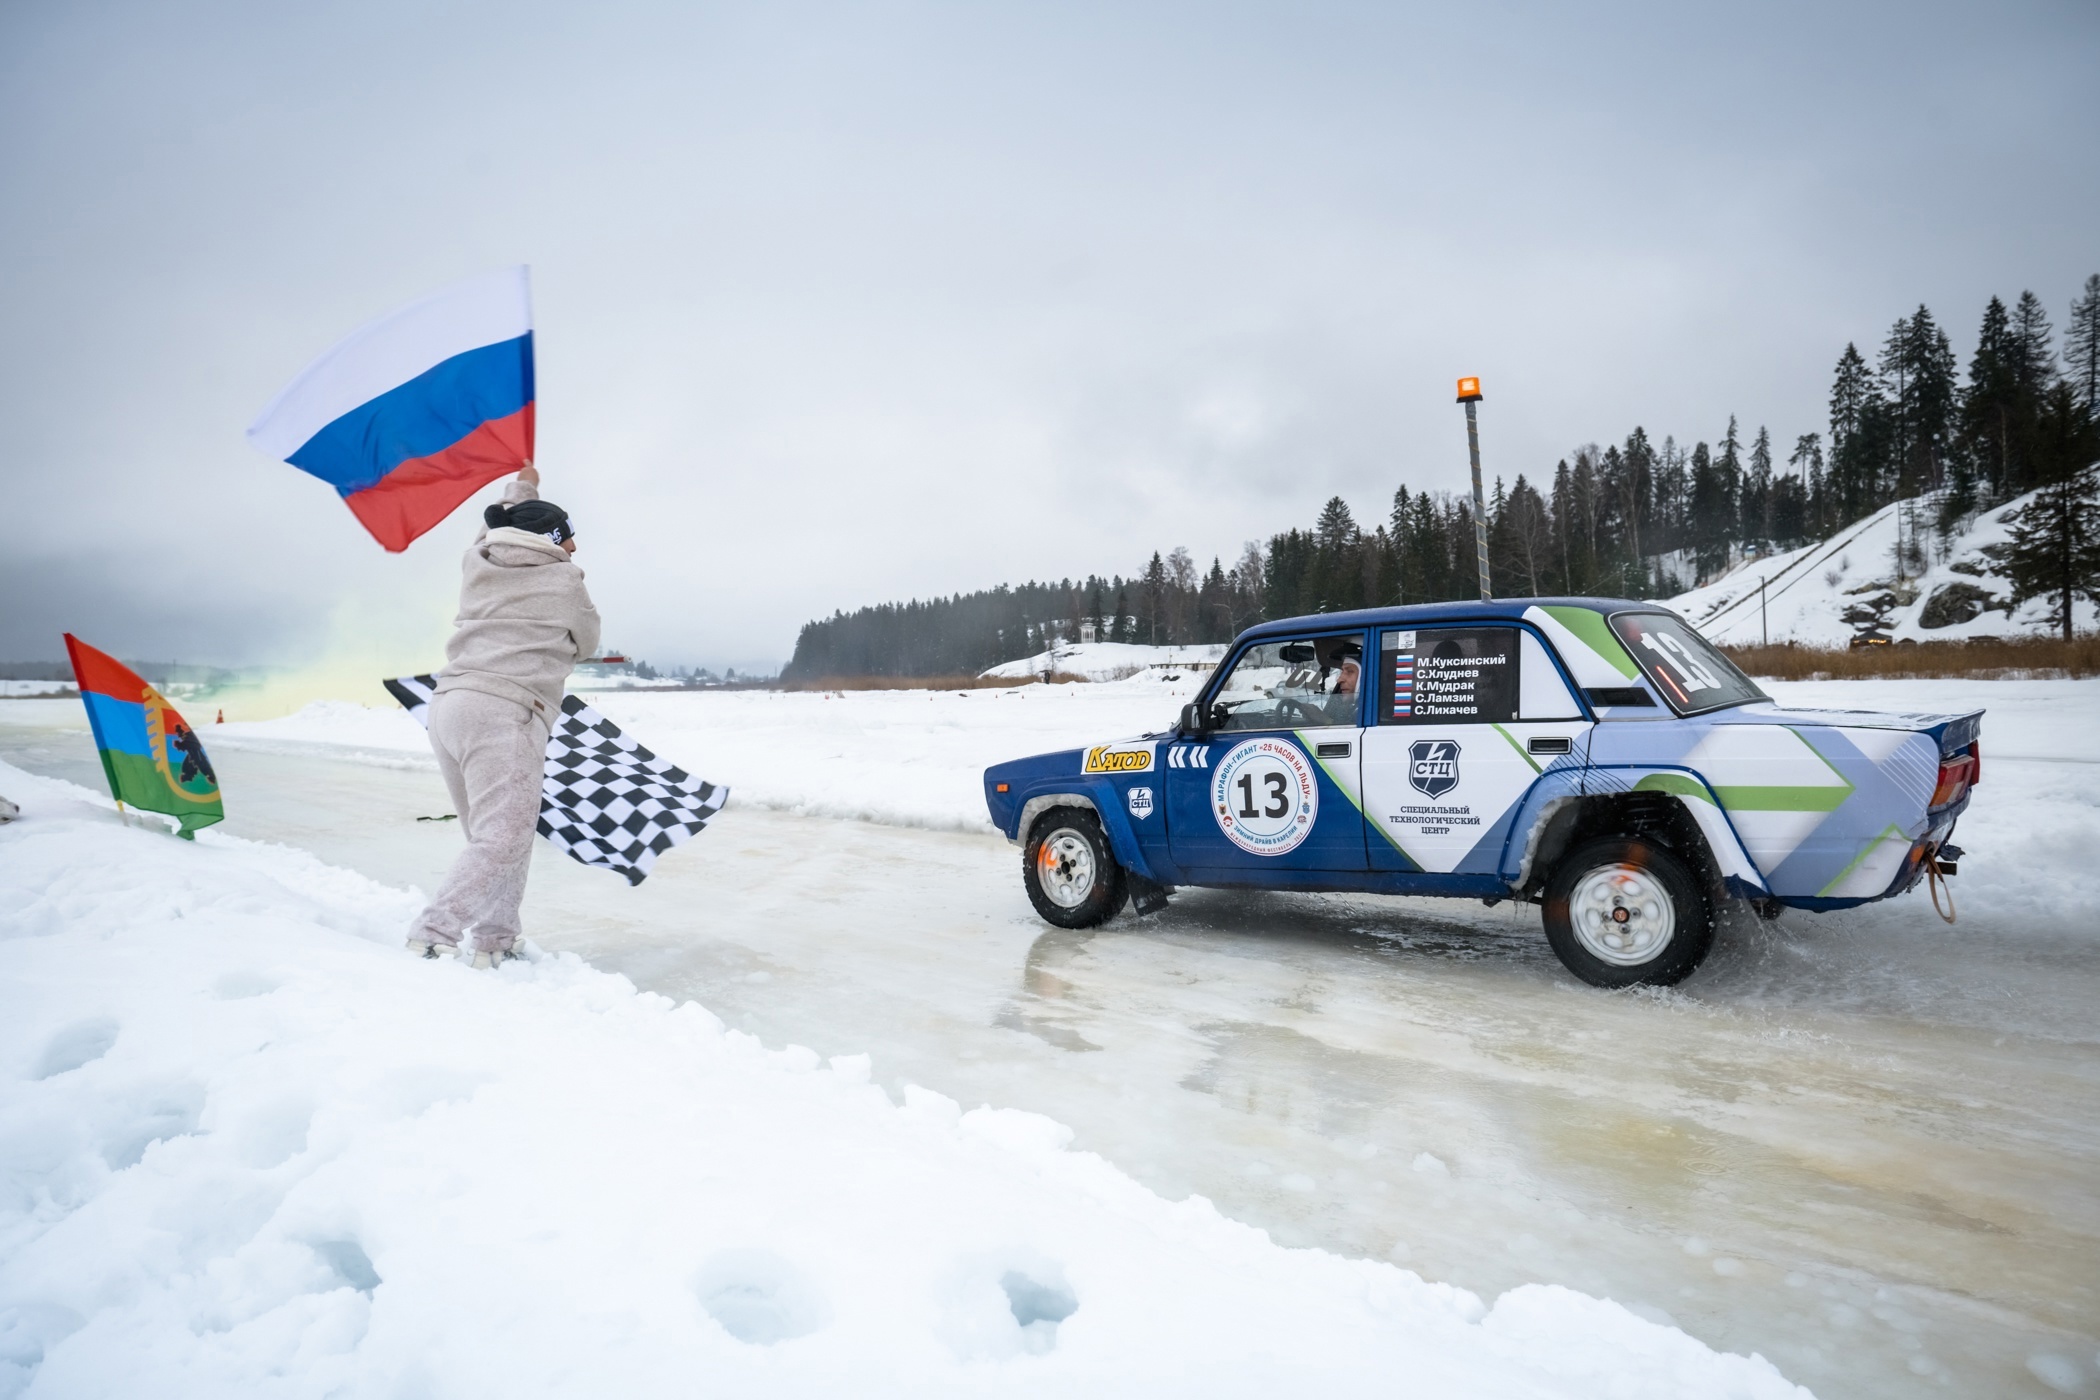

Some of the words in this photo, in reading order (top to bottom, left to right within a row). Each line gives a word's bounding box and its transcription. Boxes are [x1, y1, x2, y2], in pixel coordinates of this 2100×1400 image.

[1417, 654, 1506, 669] М.Куксинский
[1640, 632, 1721, 692] 13
[1416, 669, 1479, 681] С.Хлуднев
[1416, 681, 1475, 693] К.Мудрак
[1415, 693, 1474, 703] С.Ламзин
[1414, 705, 1478, 715] С.Лихачев
[1218, 744, 1257, 802] МАРАФОН-ГИГАНТ
[1274, 744, 1296, 763] ЧАСОВ
[1293, 760, 1303, 772] НА
[1415, 762, 1451, 777] СТЦ
[1237, 772, 1289, 819] 13
[1132, 800, 1149, 808] СТЦ
[1400, 805, 1471, 815] СПЕЦИАЛЬНЫЙ
[1389, 815, 1480, 825] ТЕХНОЛОГИЧЕСКИЙ
[1234, 825, 1254, 841] ЗИМНИЙ
[1254, 837, 1272, 845] ДРАЙВ
[1277, 825, 1298, 842] КАРЕЛИИ
[1421, 826, 1450, 835] ЦЕНТР
